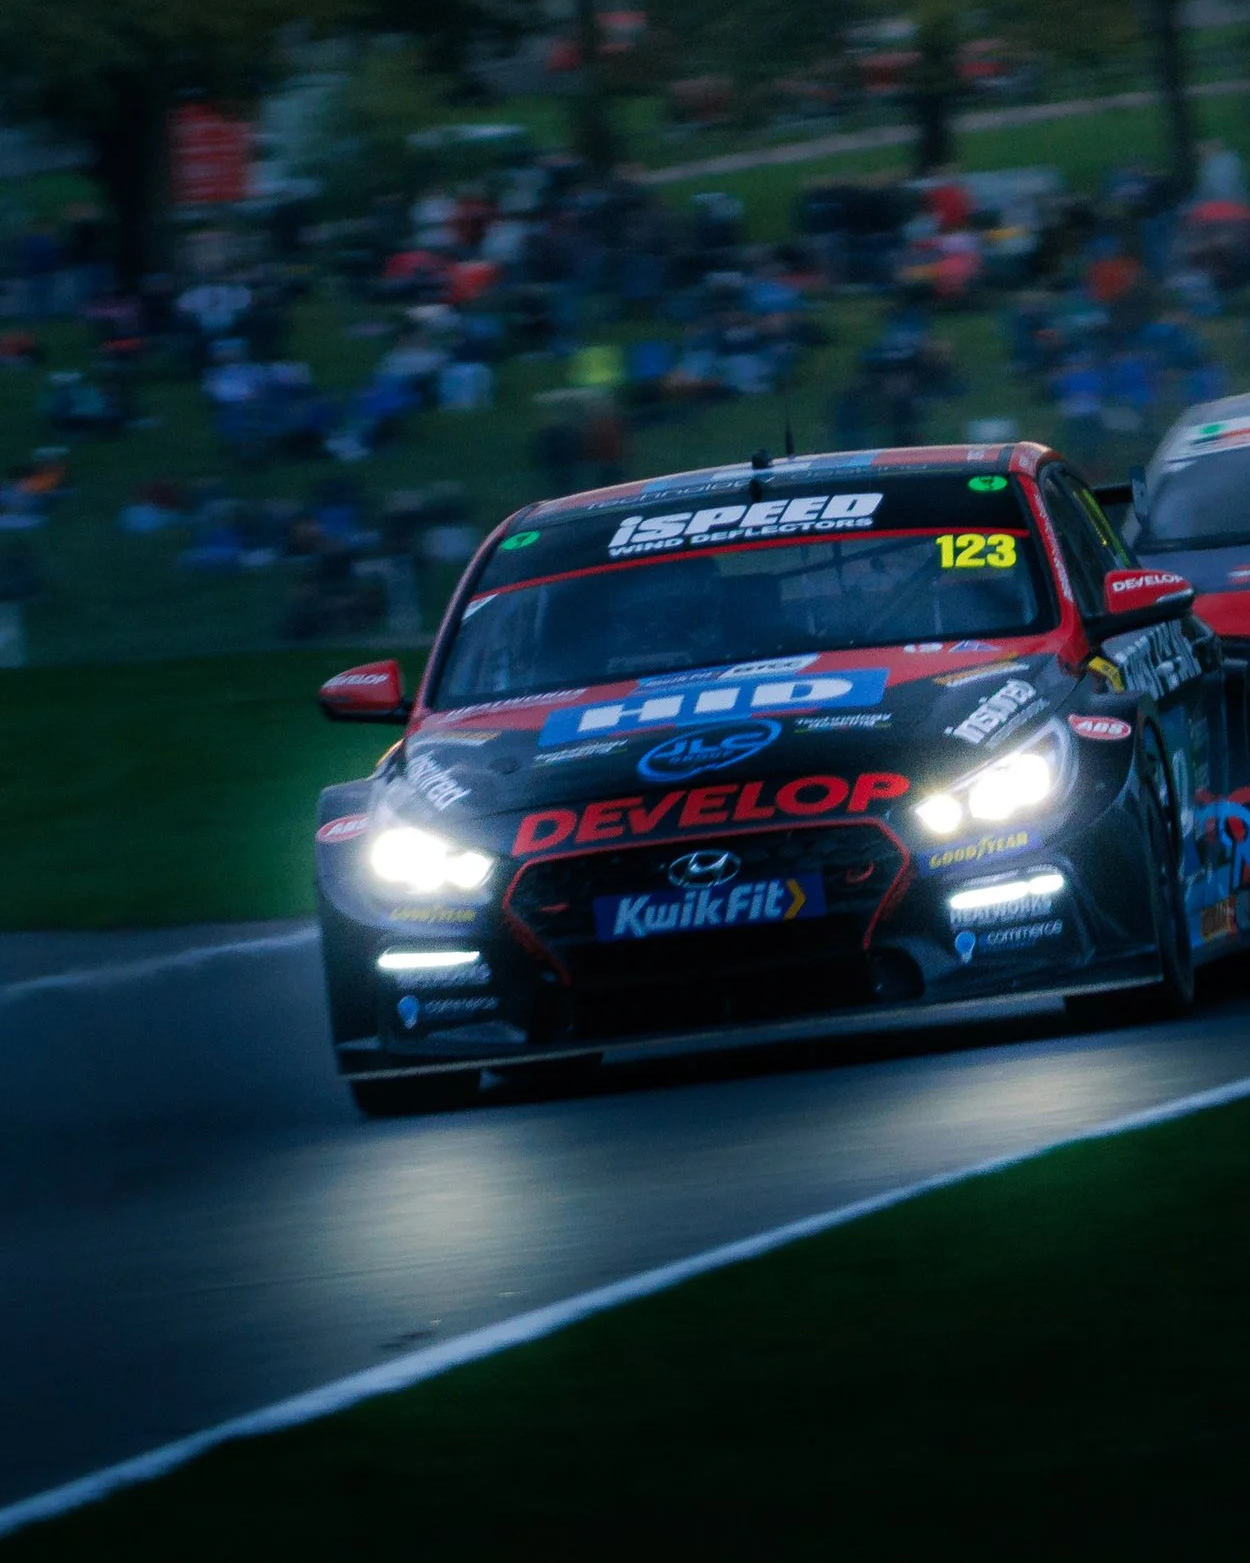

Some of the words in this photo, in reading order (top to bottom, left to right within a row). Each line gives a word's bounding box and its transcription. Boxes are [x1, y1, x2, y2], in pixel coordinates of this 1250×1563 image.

[608, 492, 884, 548] iSPEED
[608, 537, 685, 558] WIND
[690, 517, 875, 545] DEFLECTORS
[936, 533, 1017, 568] 123
[577, 678, 853, 734] HID
[513, 772, 911, 857] DEVELOP
